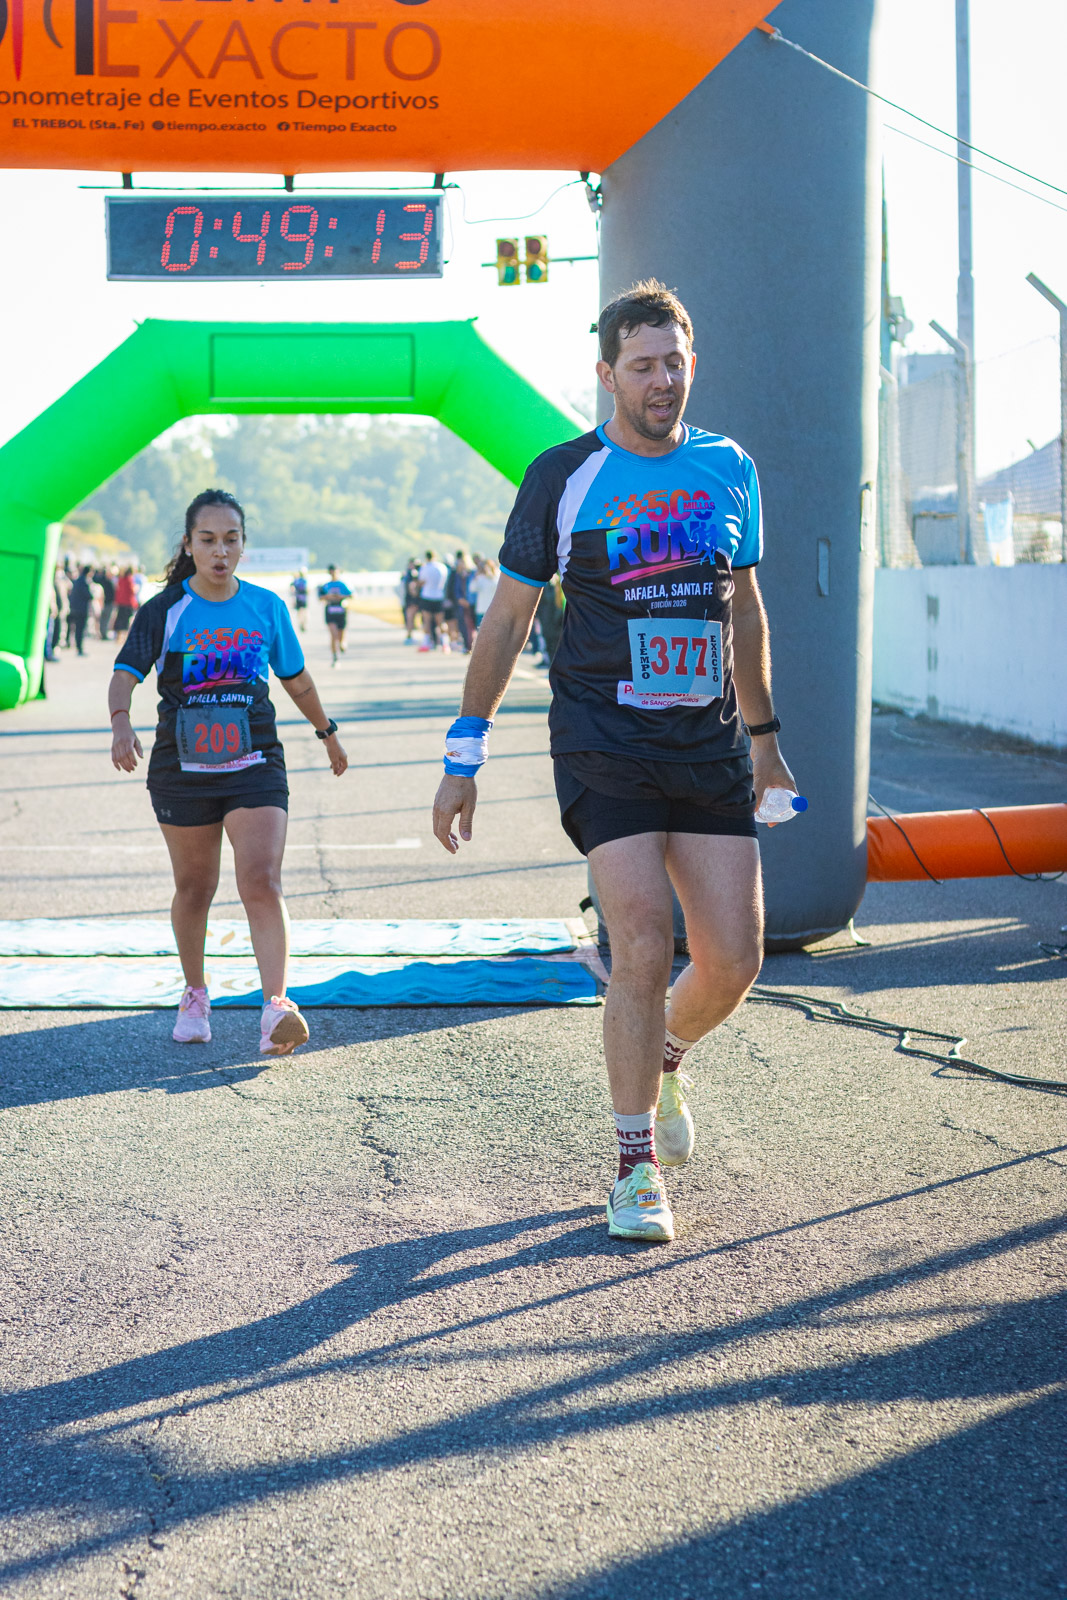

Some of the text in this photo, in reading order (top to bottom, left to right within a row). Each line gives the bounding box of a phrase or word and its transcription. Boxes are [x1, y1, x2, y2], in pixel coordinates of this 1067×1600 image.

[149, 89, 180, 107] de
[189, 90, 289, 109] Eventos
[297, 91, 440, 114] Deportivos
[13, 118, 29, 129] EL
[32, 119, 86, 129] TREBOL
[89, 120, 121, 131] (Sta.
[124, 120, 145, 131] Fe)
[293, 122, 397, 133] Tiempo Exacto
[646, 489, 713, 522] 500
[683, 501, 716, 511] MILLAS
[606, 521, 704, 571] RUN
[623, 582, 713, 602] RAFAELA, SANTA FE
[651, 599, 687, 610] EDICIÓN 2026
[637, 633, 650, 680] TIEMPO
[649, 636, 708, 676] 377
[709, 635, 719, 683] EXACTO
[220, 693, 246, 703] SANTA
[194, 722, 240, 753] 209
